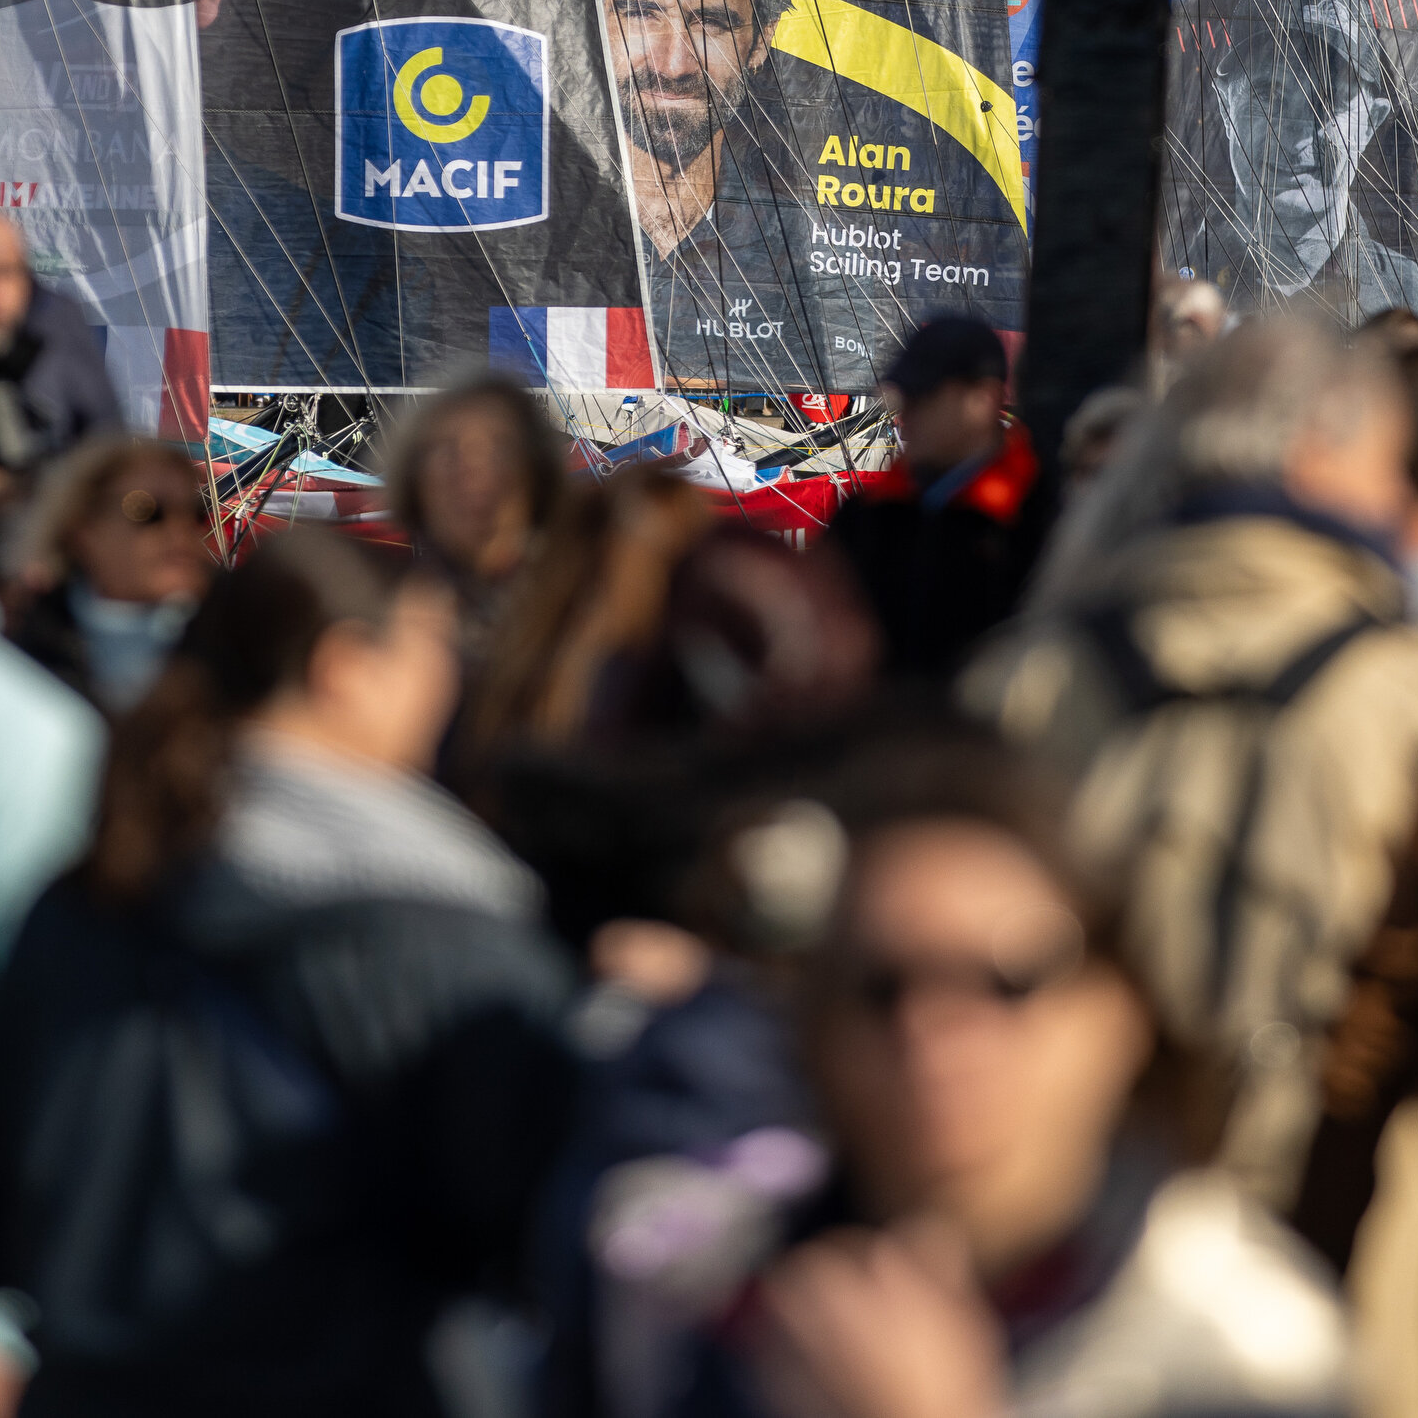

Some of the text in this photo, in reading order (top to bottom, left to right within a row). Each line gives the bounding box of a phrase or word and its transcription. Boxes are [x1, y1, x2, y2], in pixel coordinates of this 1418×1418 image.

[818, 135, 911, 172] Alan
[364, 159, 523, 200] MACIF
[816, 175, 935, 214] Roura
[811, 223, 902, 251] Hublot
[809, 250, 989, 287] Sailing Team
[696, 319, 784, 339] HUBLOT
